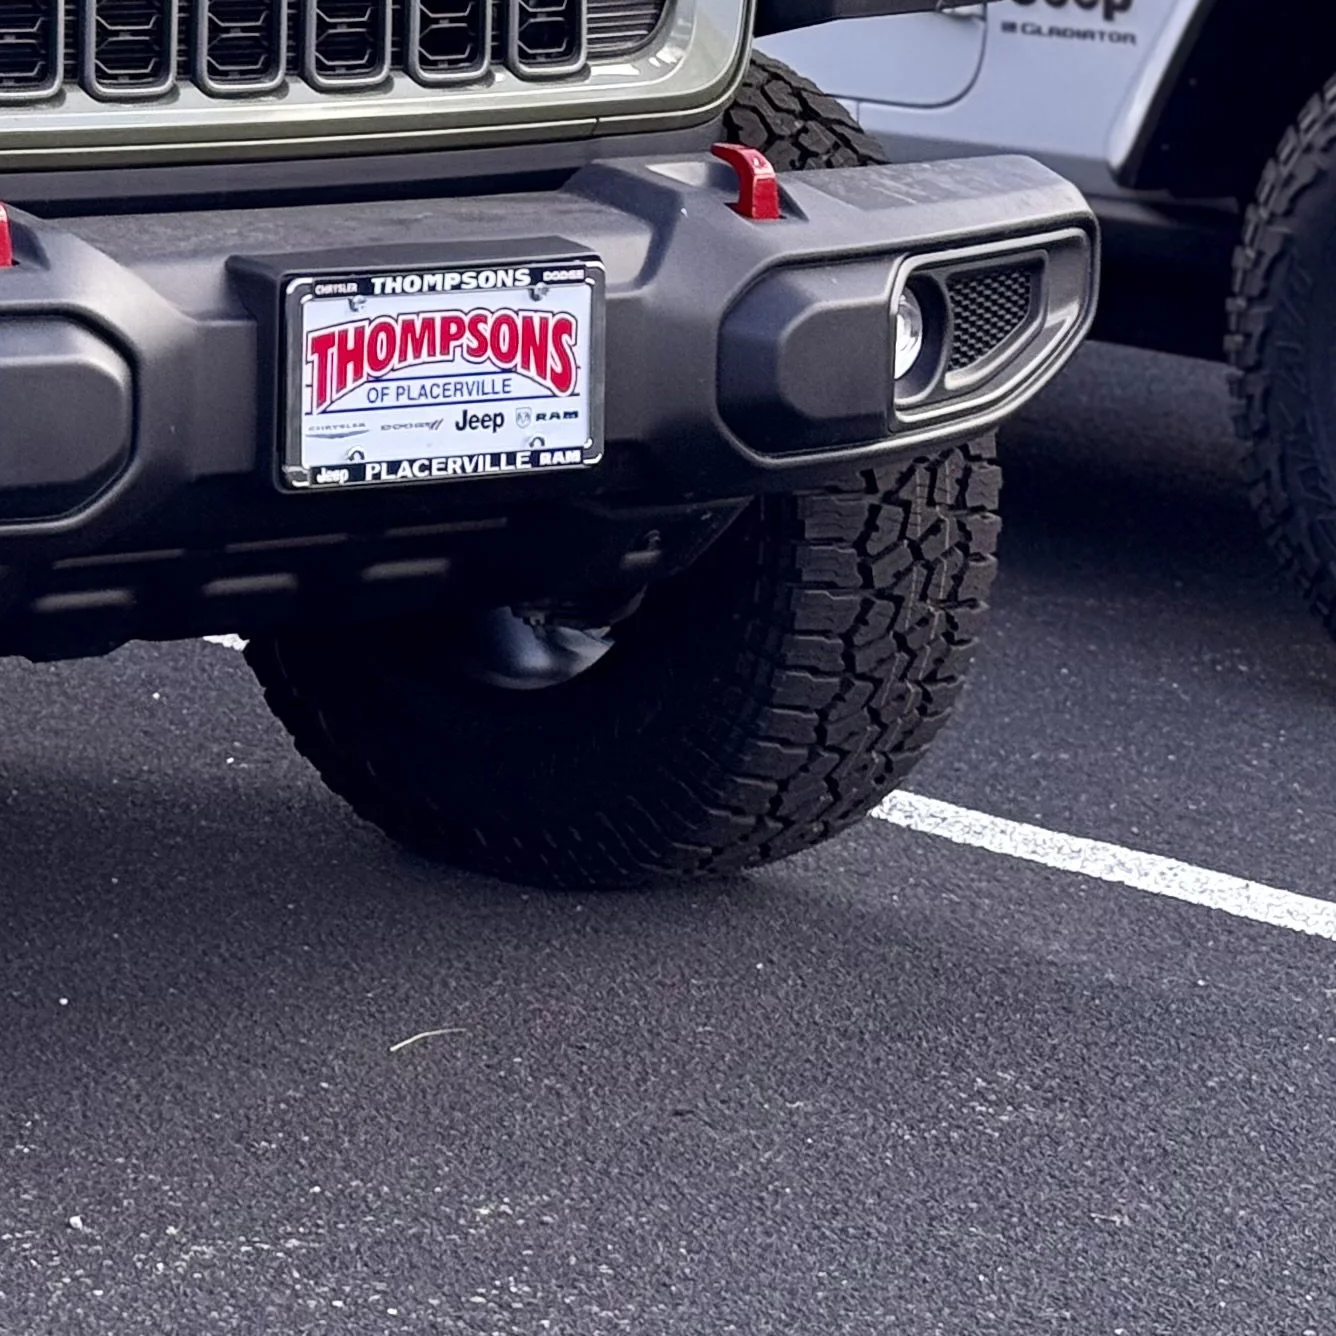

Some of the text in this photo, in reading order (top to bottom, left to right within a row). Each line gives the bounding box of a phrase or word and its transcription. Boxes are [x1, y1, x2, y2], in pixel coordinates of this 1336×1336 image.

[1020, 22, 1137, 46] GLADIATOR
[315, 282, 358, 295] CHRYSLER
[371, 268, 532, 294] THOMPSONS
[311, 313, 573, 410] THOMPSONS
[367, 378, 513, 403] OF PLACERVILLE
[455, 409, 505, 433] Jeep
[535, 410, 579, 422] RAM
[316, 450, 581, 484] Jeep PLACERVILLE RAM
